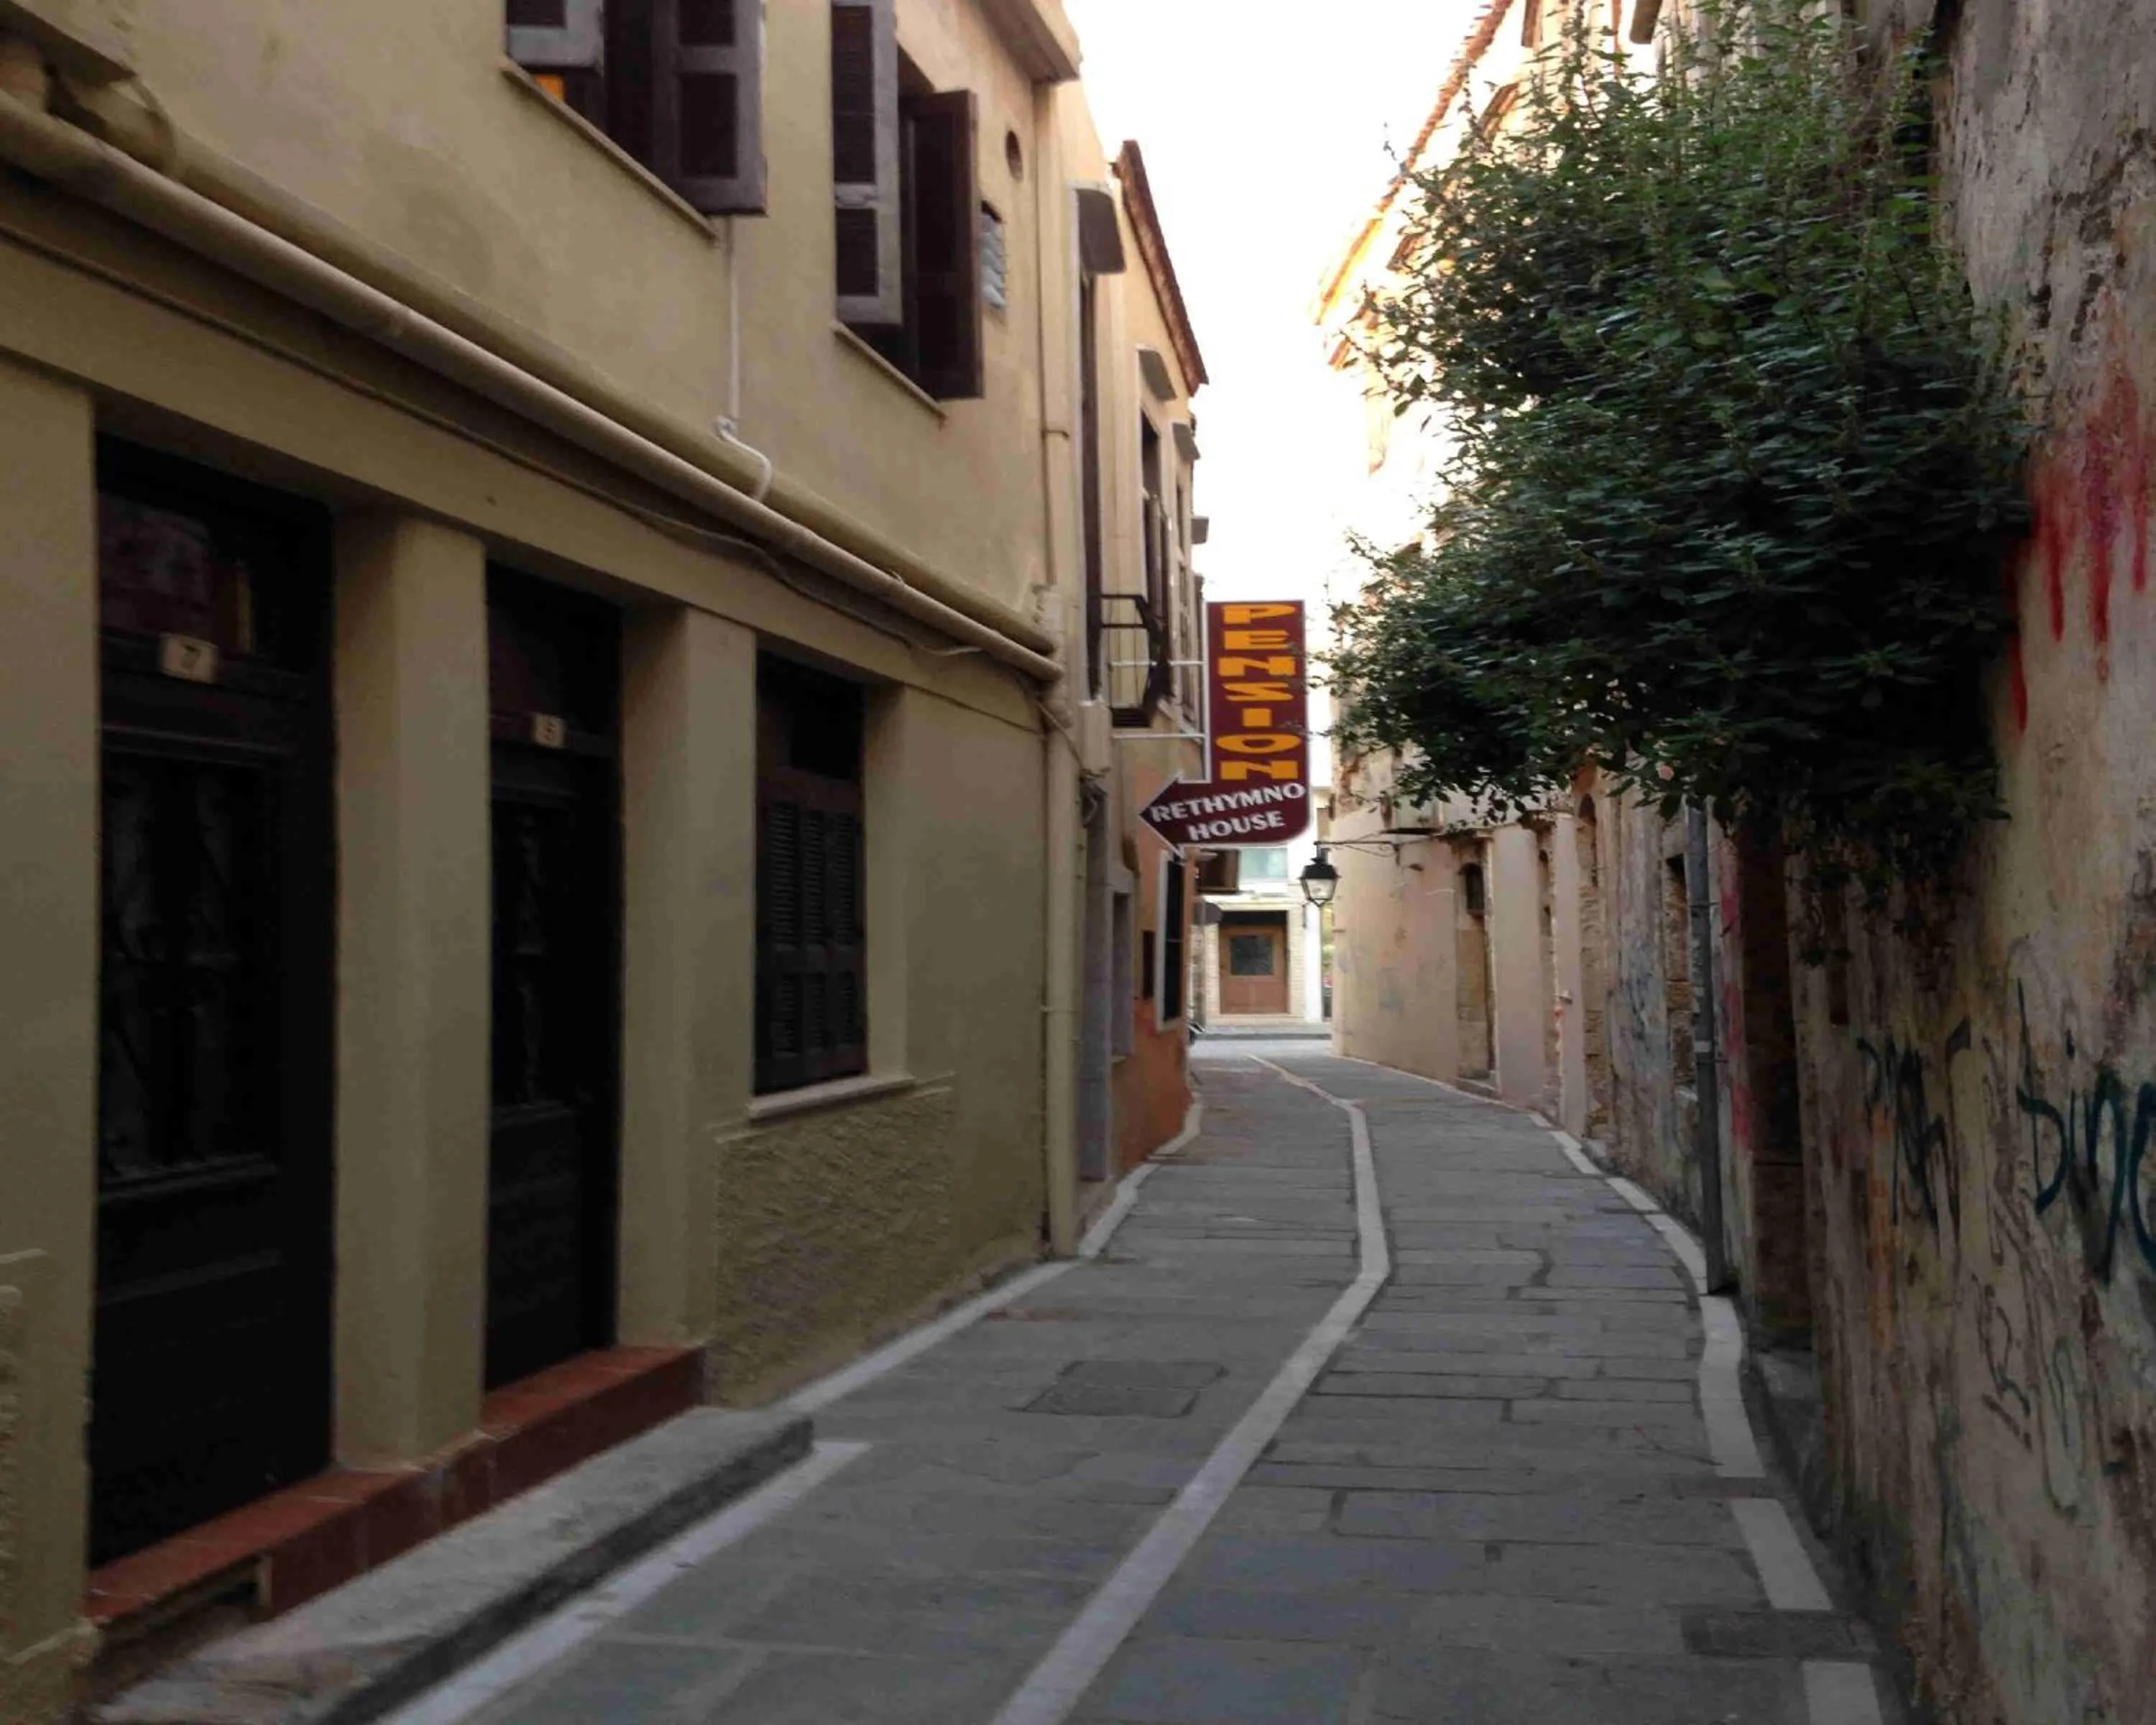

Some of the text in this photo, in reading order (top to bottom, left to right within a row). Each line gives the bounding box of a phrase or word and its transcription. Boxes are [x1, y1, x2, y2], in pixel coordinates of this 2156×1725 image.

[178, 637, 201, 670] 7
[1216, 604, 1302, 780] PENSION
[1150, 783, 1306, 822] RETHYMNO
[1189, 811, 1285, 841] HOUSE
